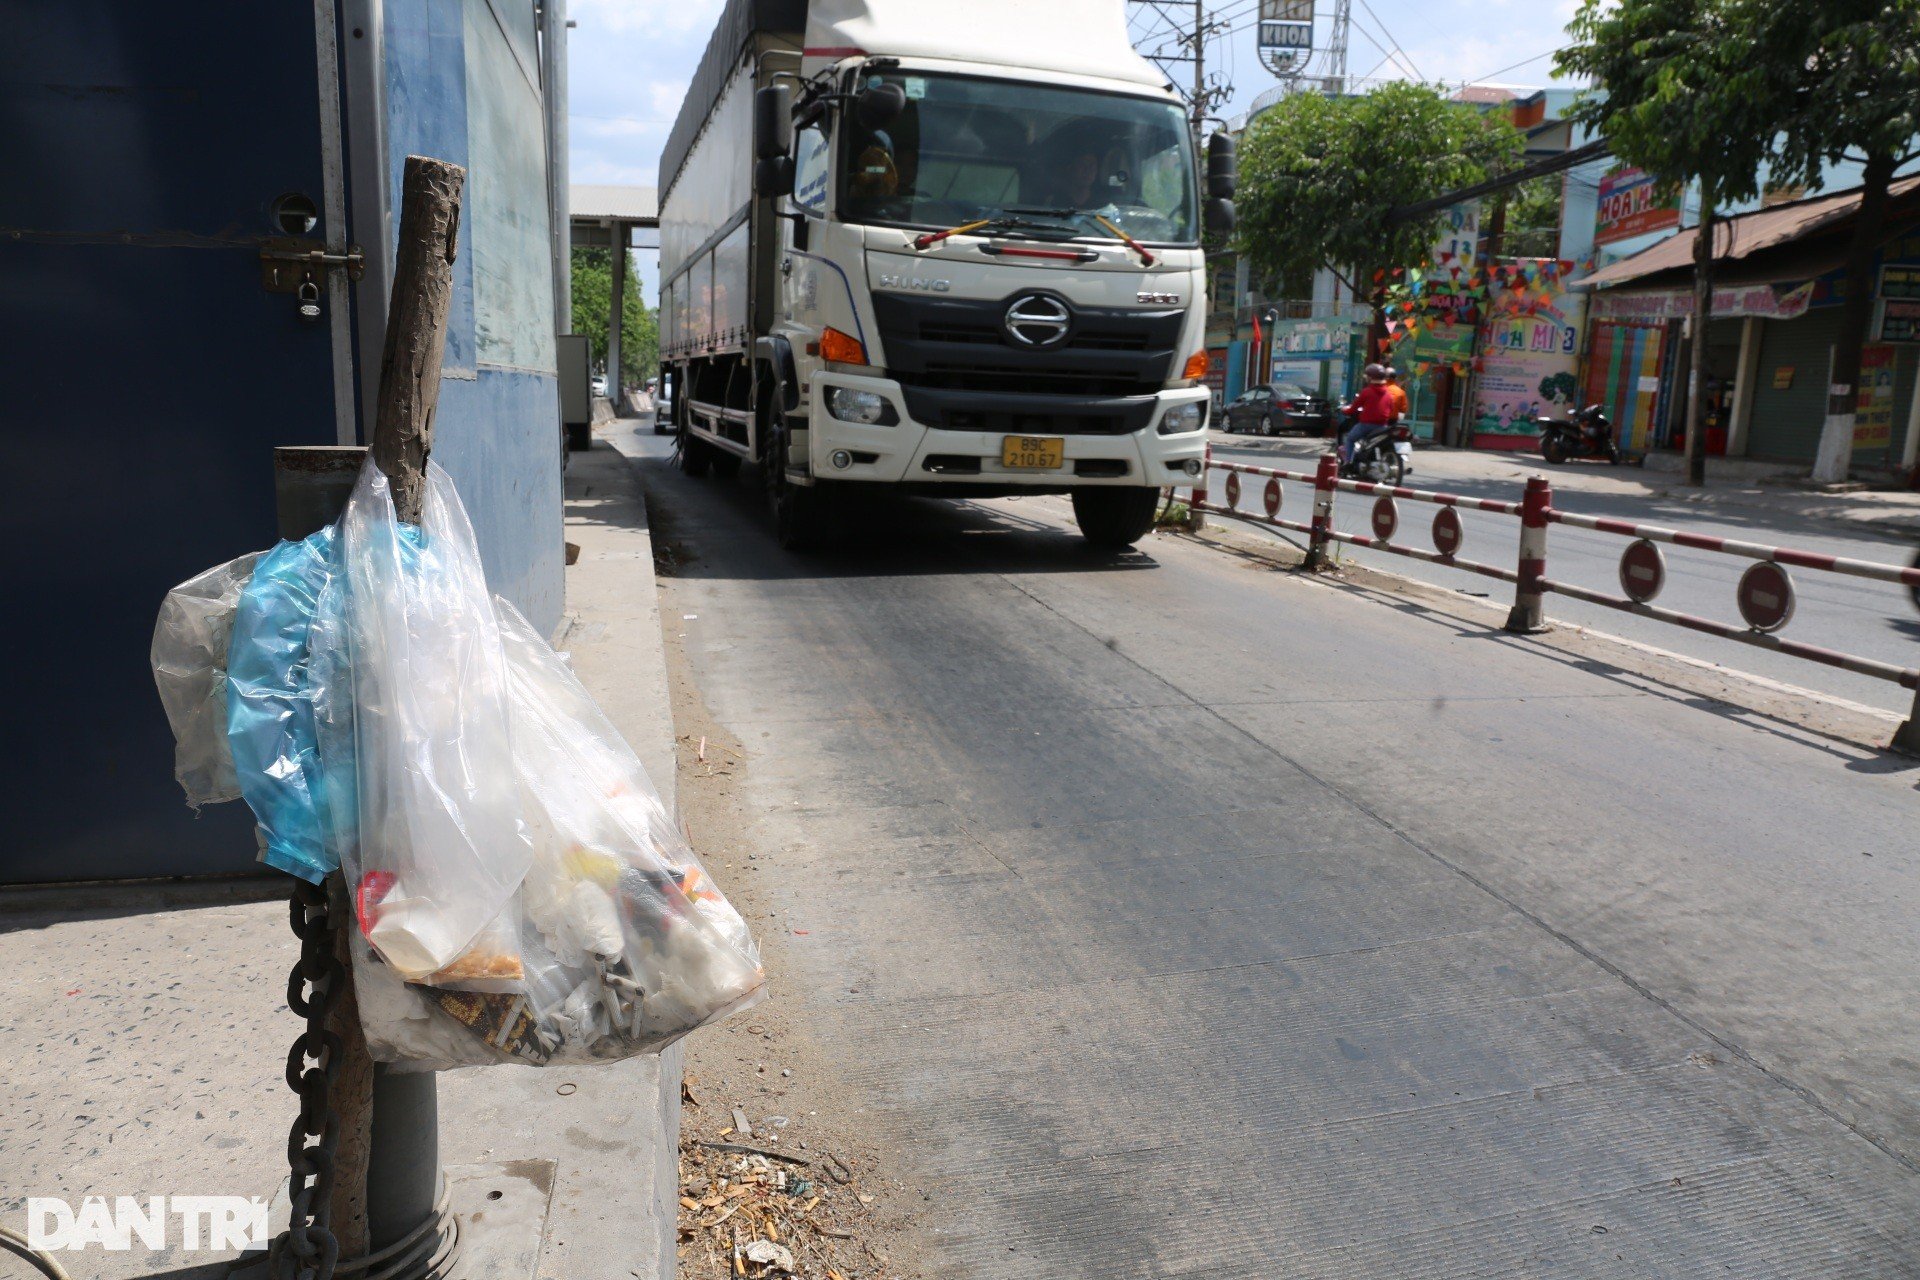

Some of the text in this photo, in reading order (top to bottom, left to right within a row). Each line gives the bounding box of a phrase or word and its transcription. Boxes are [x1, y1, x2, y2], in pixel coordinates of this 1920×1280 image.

[1262, 25, 1310, 46] KHOA
[880, 275, 951, 292] HINO
[1530, 323, 1556, 353] MI
[1562, 326, 1577, 354] 3
[1021, 438, 1047, 452] 89C
[1010, 452, 1056, 467] 210.67
